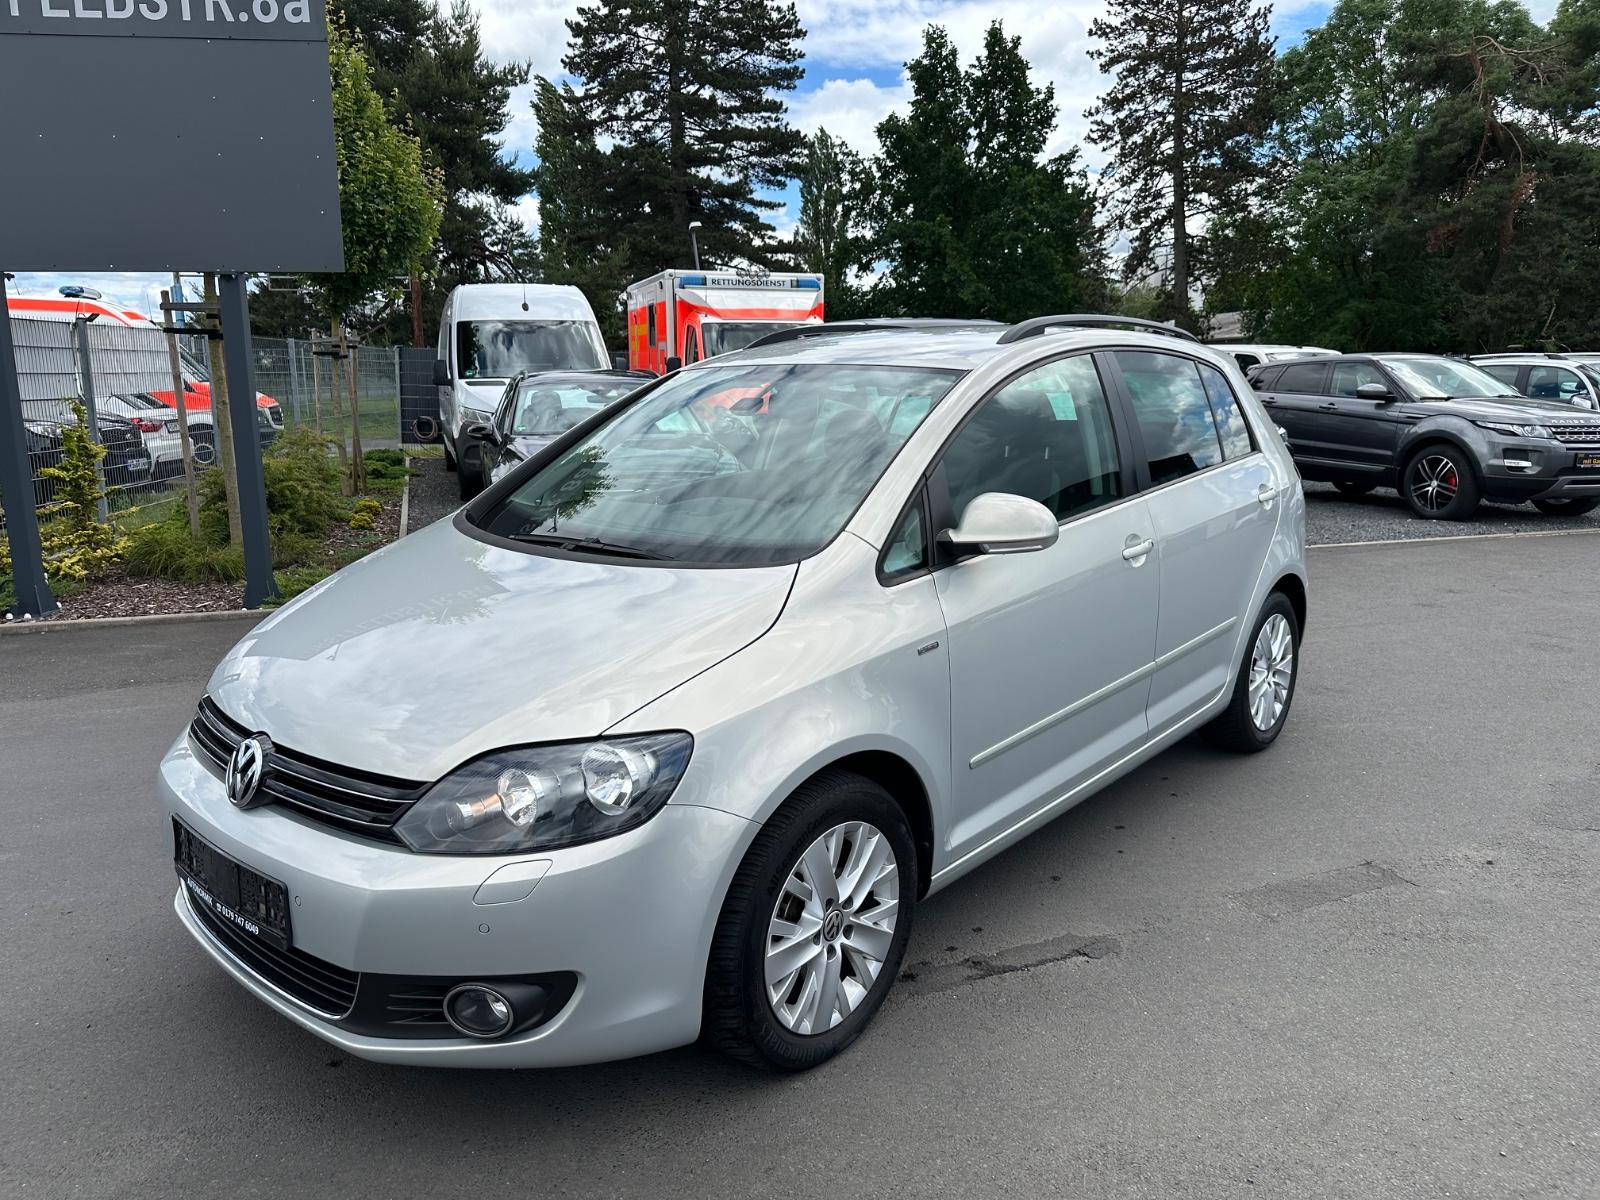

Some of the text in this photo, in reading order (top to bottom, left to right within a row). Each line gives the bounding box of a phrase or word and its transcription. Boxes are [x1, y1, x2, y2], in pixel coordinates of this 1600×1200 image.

[711, 278, 786, 287] RETTUNGSDIENST
[234, 913, 245, 927] 747
[244, 920, 259, 935] 6049
